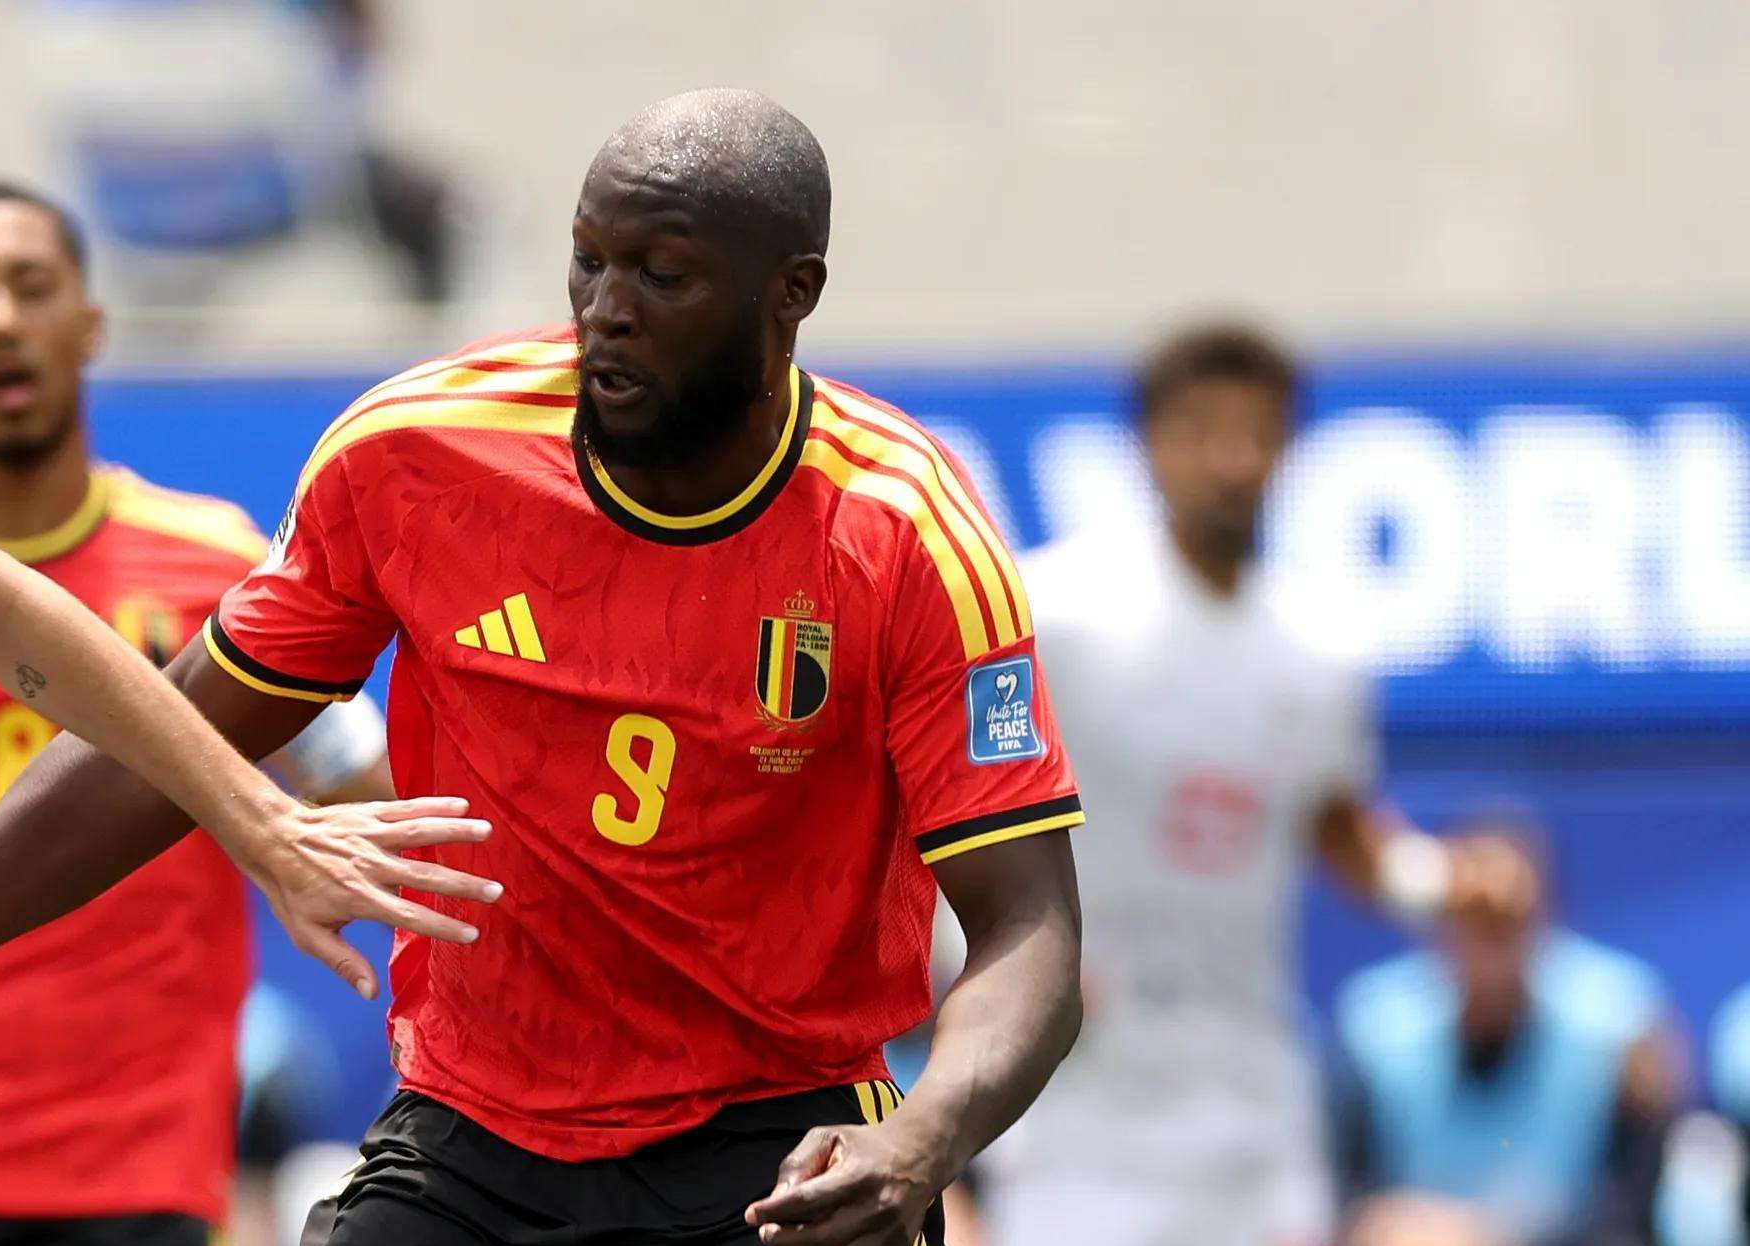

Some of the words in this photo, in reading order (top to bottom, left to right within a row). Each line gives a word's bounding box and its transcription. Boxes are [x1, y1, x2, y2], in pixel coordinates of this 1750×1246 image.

[797, 623, 821, 633] ROYAL
[796, 632, 830, 642] BELGIAN
[988, 719, 1028, 741] PEACE
[997, 738, 1022, 752] FIFA
[592, 713, 676, 846] 9
